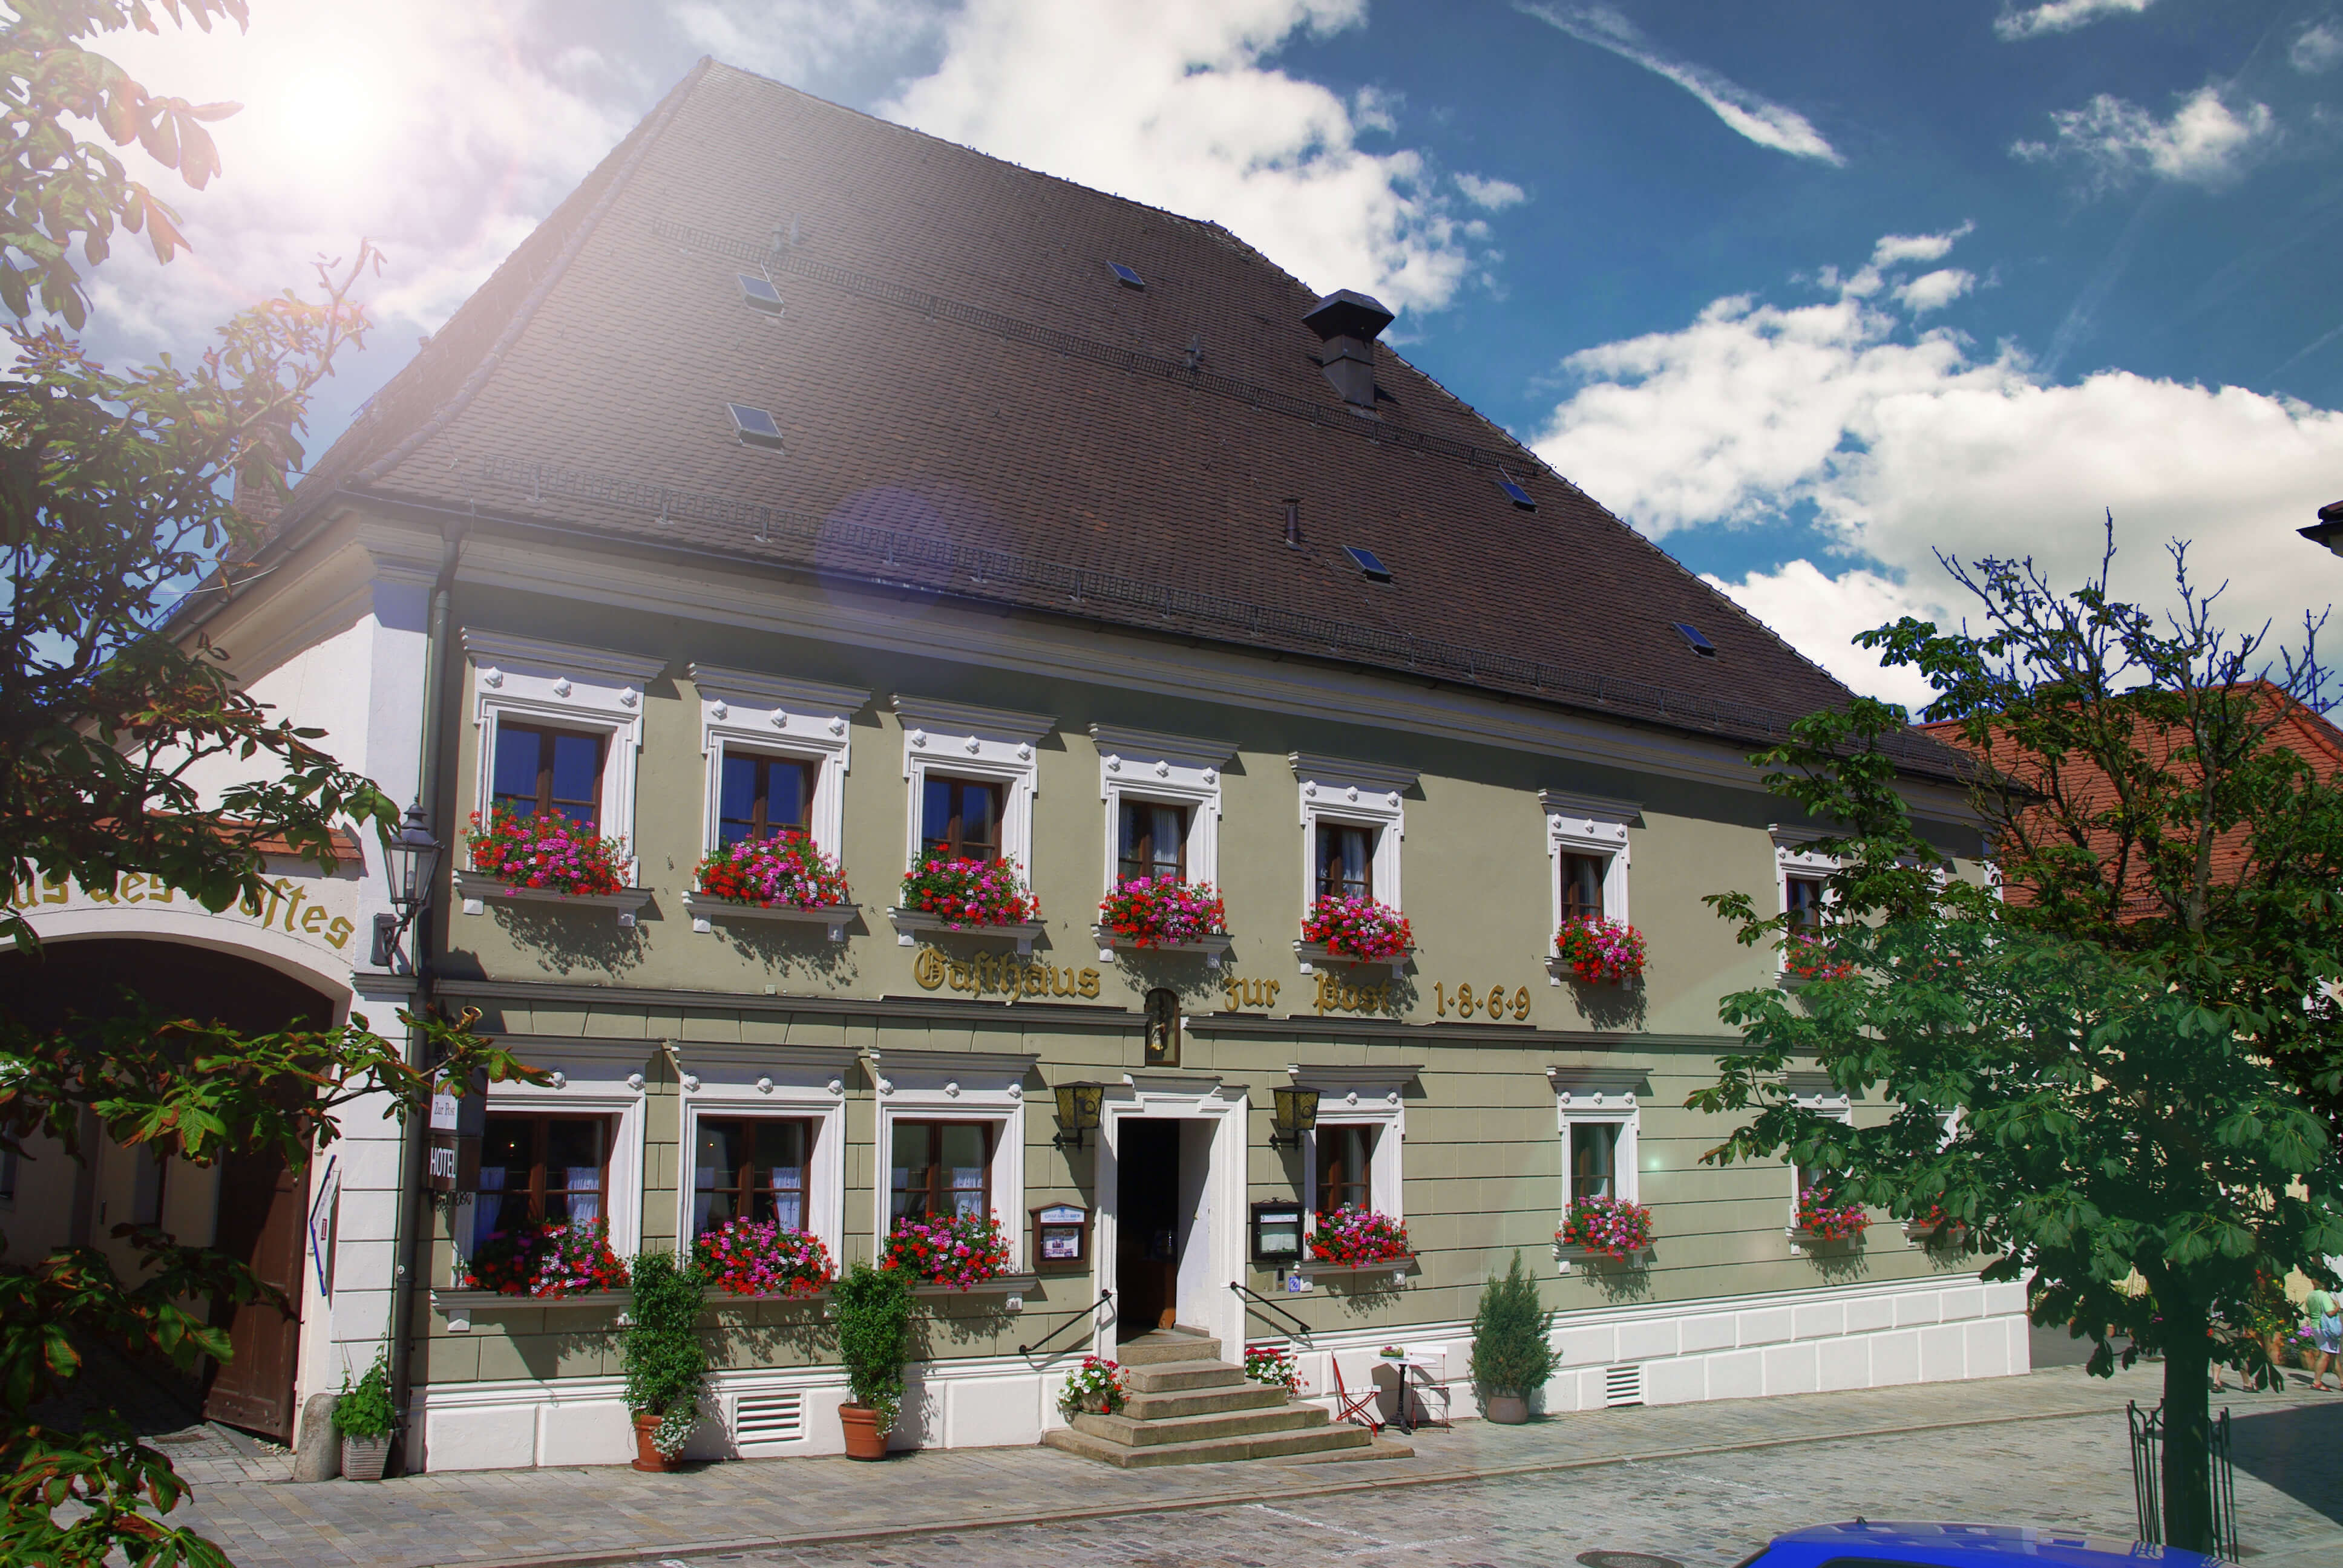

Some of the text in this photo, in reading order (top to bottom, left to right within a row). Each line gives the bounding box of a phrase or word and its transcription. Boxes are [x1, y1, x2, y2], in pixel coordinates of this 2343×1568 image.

[198, 878, 355, 949] astes
[1224, 977, 1280, 1011] zur
[1312, 973, 1392, 1016] Post
[434, 1102, 456, 1116] Zur Post
[430, 1147, 456, 1178] HOTEL
